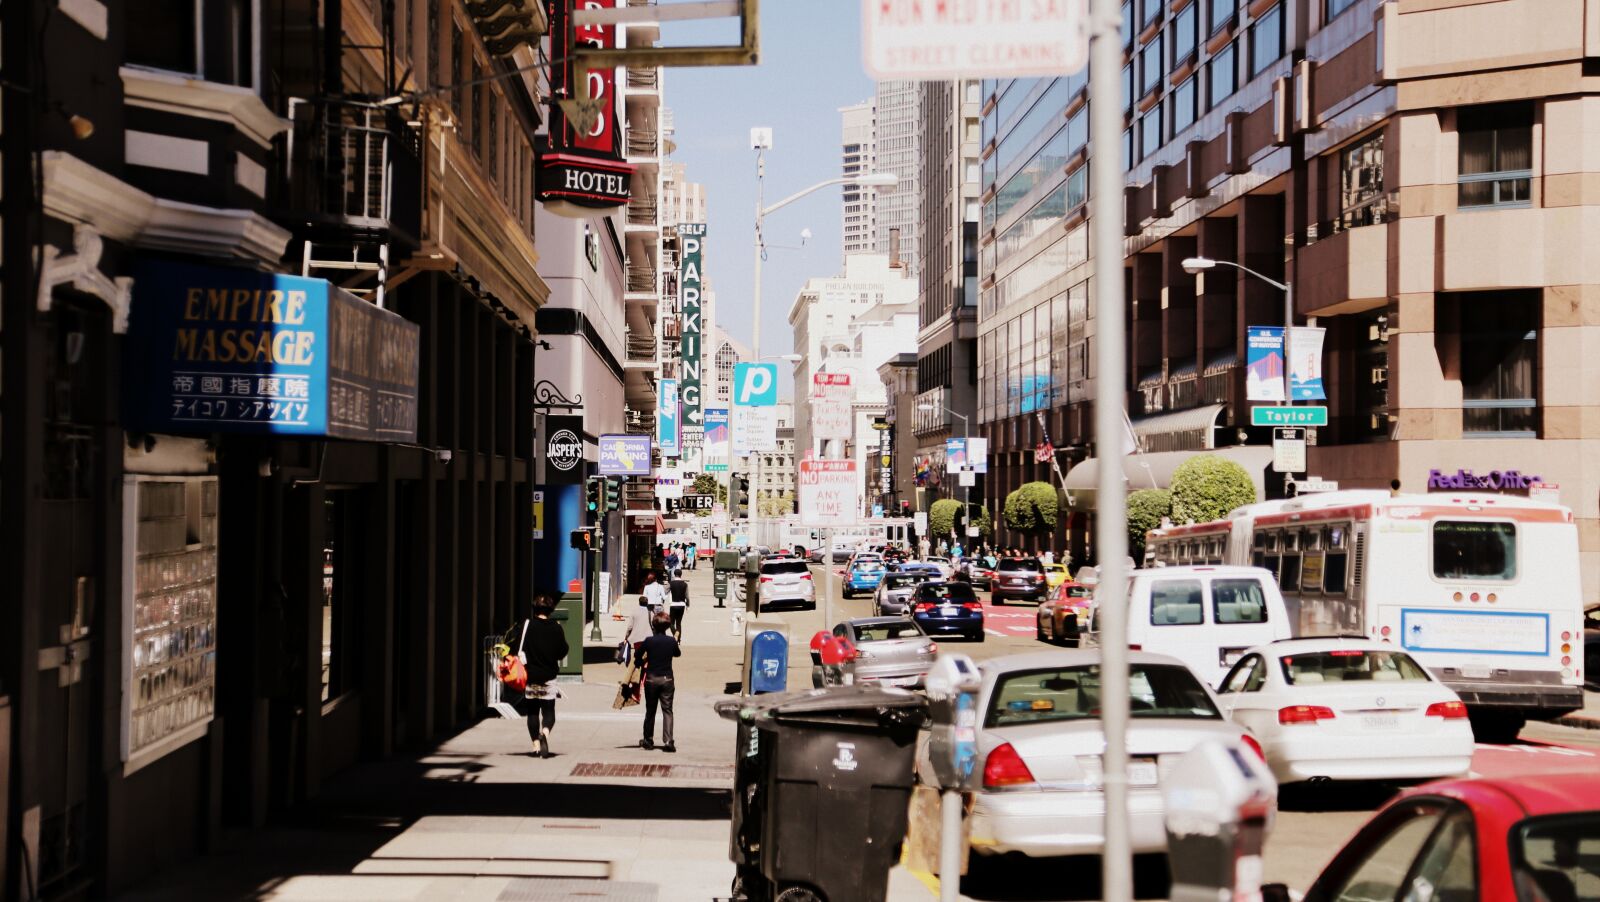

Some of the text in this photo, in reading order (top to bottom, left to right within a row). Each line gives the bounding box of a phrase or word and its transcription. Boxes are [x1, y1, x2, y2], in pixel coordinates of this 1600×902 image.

[886, 42, 1066, 67] STREET CLEANING
[565, 168, 628, 196] HOTEL
[679, 224, 706, 235] SELF
[183, 287, 307, 325] EMPIRE
[683, 238, 700, 406] PARKING
[173, 327, 315, 367] MASSAGE
[1266, 411, 1314, 424] Taylor
[682, 433, 704, 441] ENTER
[547, 443, 583, 458] JASPER'S
[802, 472, 855, 484] NO PARKING
[1429, 469, 1488, 489] FedEx
[817, 490, 840, 500] ANY
[671, 497, 713, 509] ENTER
[816, 503, 842, 512] TIME
